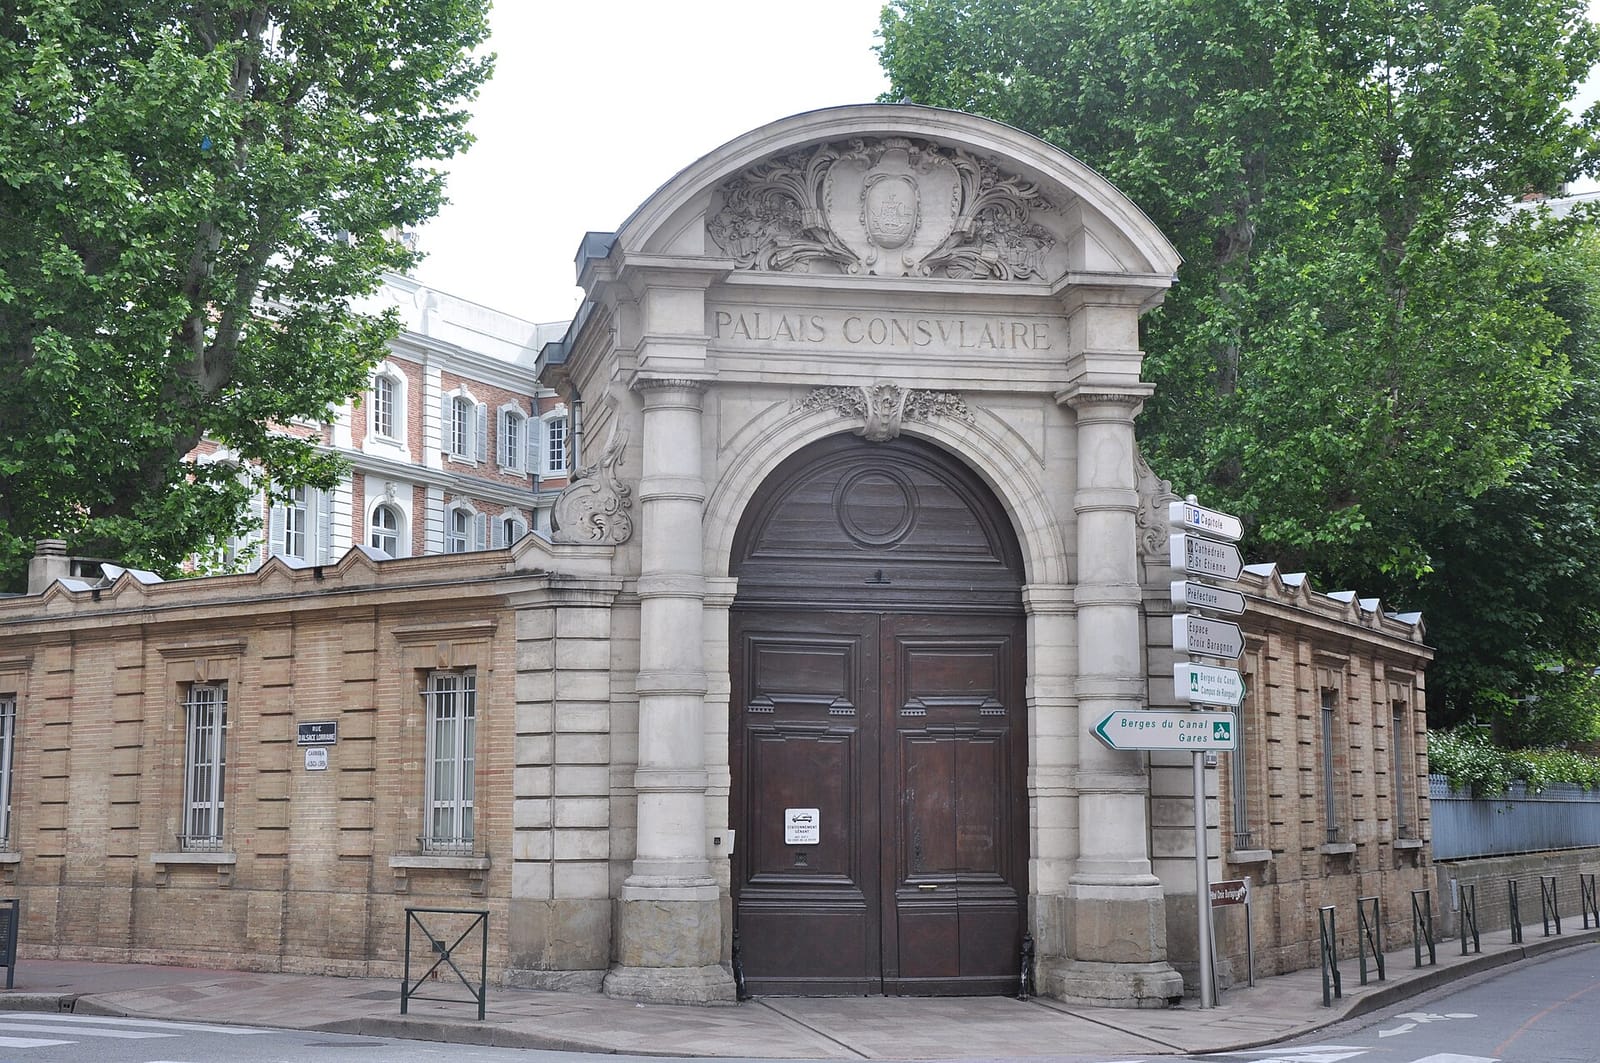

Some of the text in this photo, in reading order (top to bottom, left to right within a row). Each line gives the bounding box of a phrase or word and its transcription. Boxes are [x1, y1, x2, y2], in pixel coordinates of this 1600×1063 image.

[713, 311, 1053, 350] PALAIS CONSVLAIRE
[1201, 513, 1223, 529] Capitole
[1195, 542, 1225, 558] Cathédrale
[1188, 588, 1217, 603] Préfecture
[1189, 621, 1208, 635] Espace
[1190, 636, 1233, 653] Croix Baragnon
[1200, 672, 1237, 686] Berges du Canal
[1121, 718, 1208, 730] Berges du Canal
[1178, 733, 1208, 743] Gares
